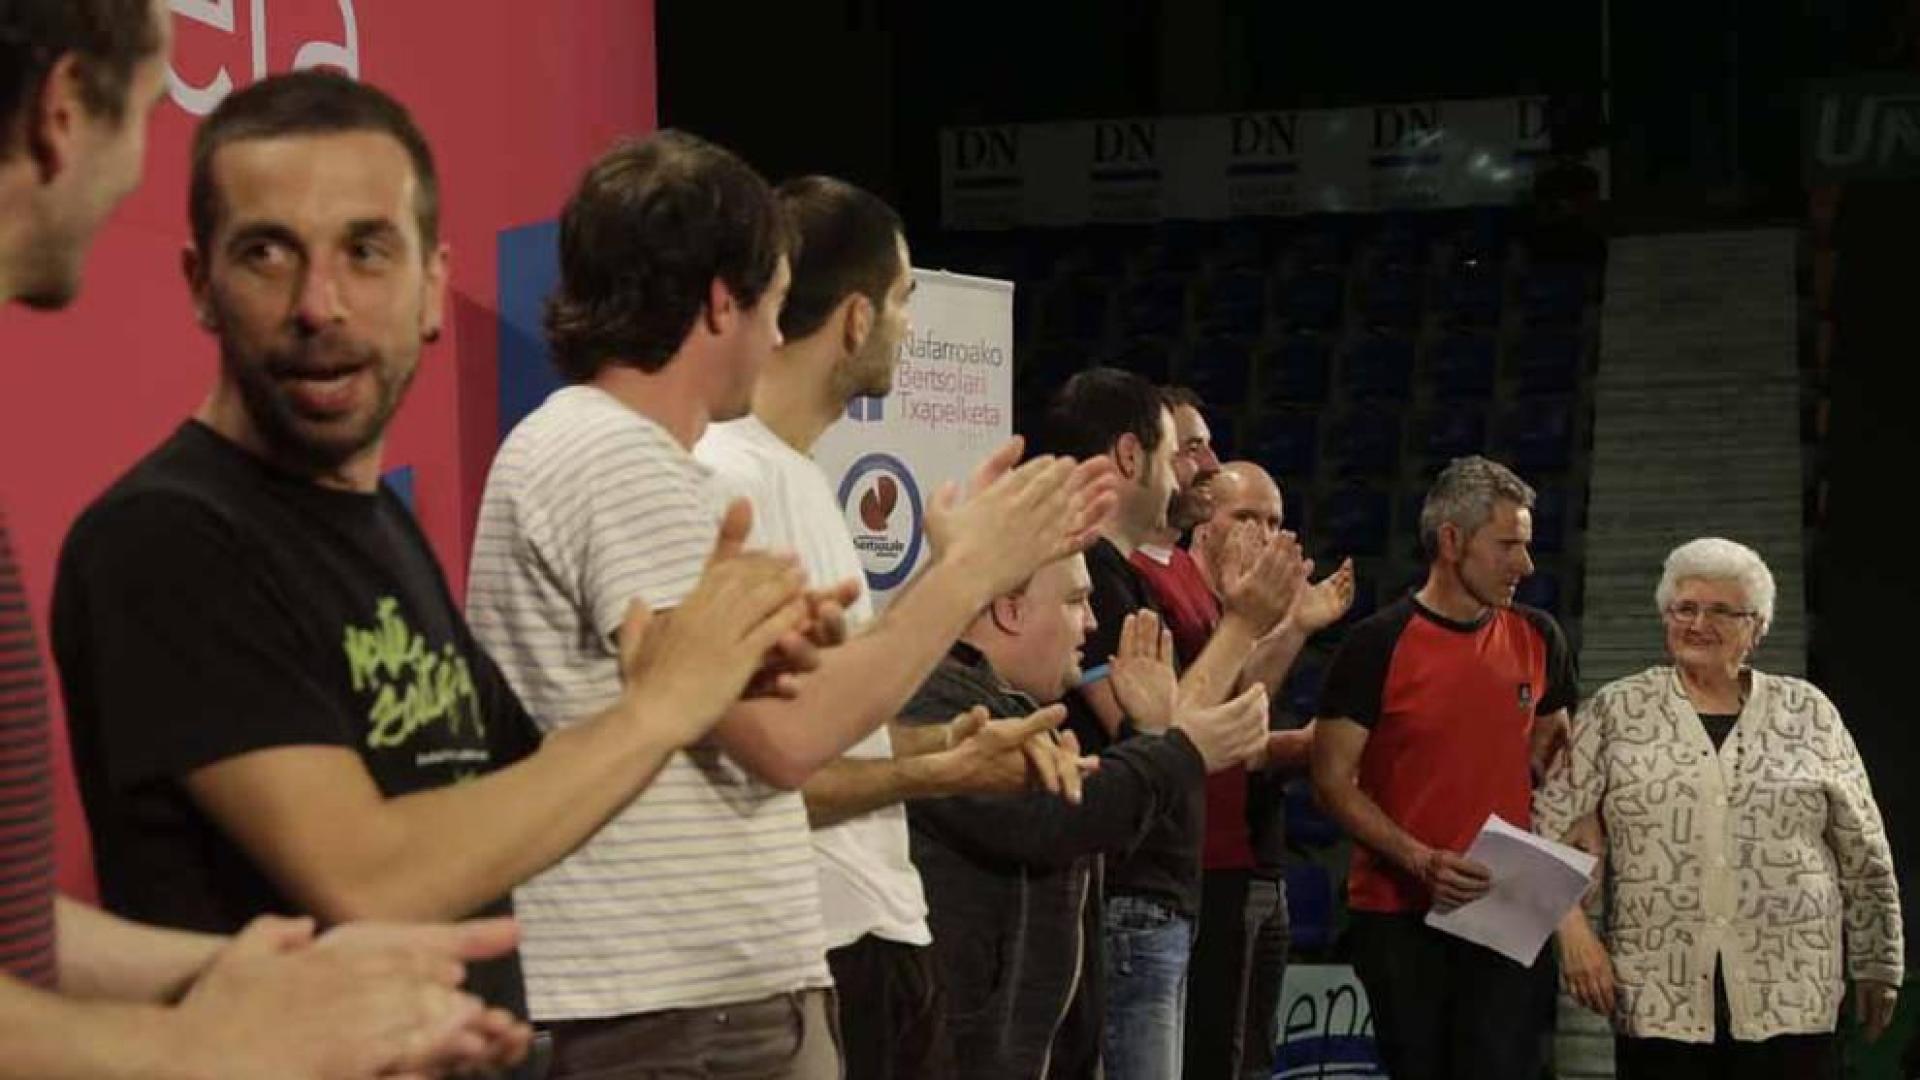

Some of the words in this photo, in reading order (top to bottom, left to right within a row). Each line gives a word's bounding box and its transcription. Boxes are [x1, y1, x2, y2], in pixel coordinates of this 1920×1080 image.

[1093, 122, 1156, 162] DN
[1230, 115, 1297, 154] DN
[1374, 106, 1439, 147] DN
[956, 128, 1019, 169] DN
[899, 362, 987, 395] Bertsolari
[897, 391, 1002, 430] Txapelketa
